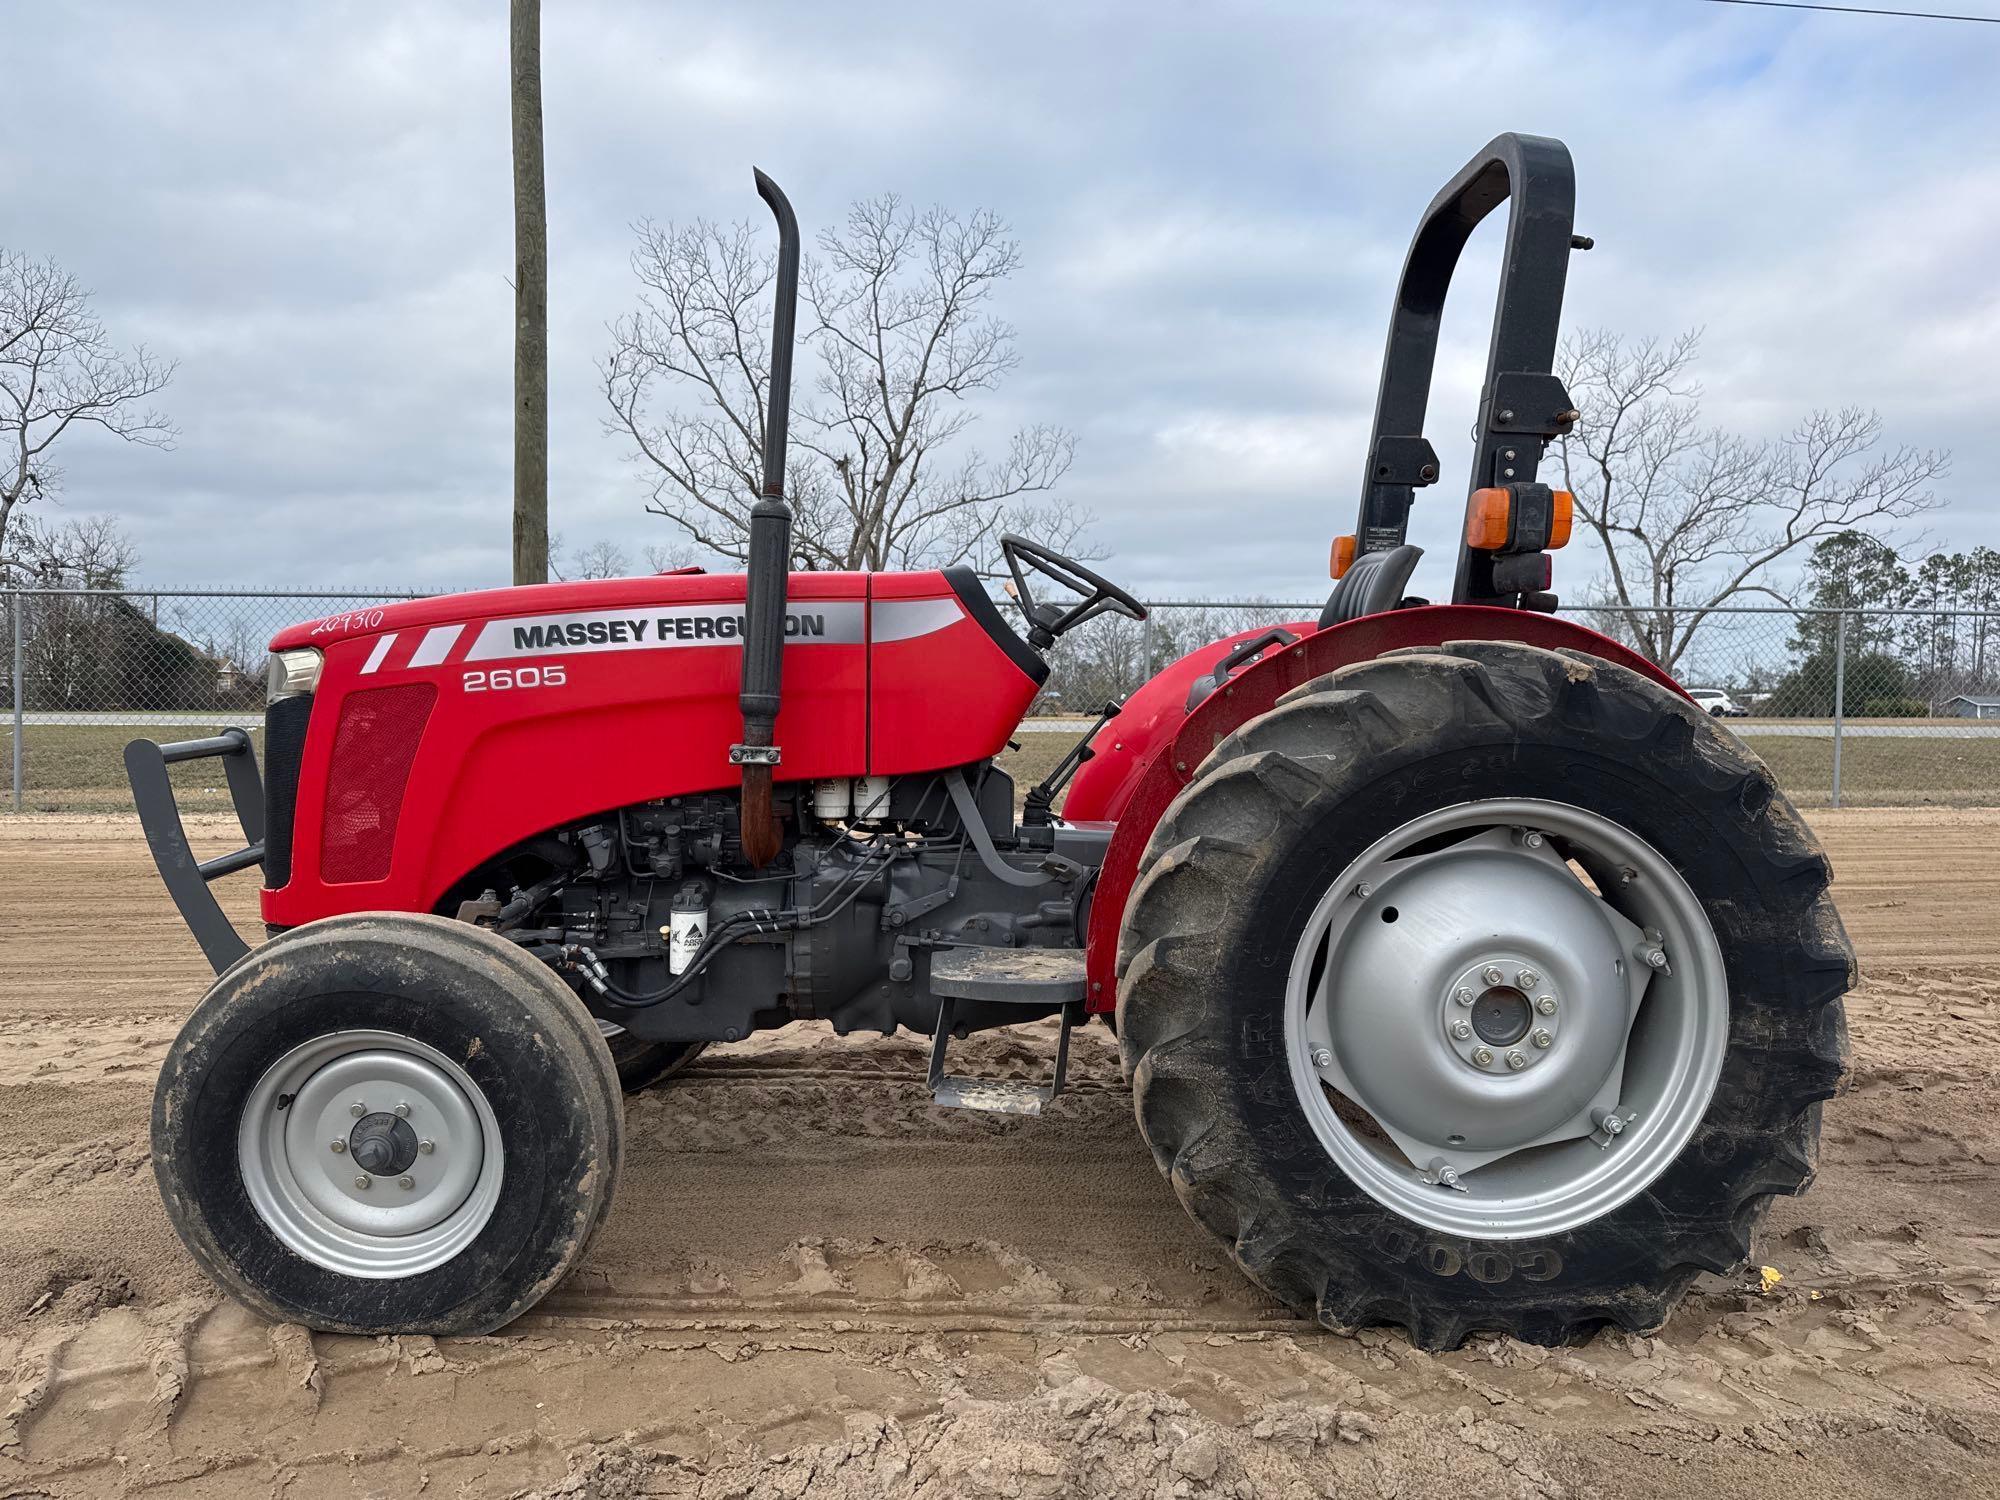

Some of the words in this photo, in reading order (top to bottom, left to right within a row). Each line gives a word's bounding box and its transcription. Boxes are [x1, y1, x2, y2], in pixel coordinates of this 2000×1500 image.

[311, 610, 384, 635] 209310
[513, 619, 649, 650] MASSEY
[657, 614, 825, 641] FERGON
[463, 665, 567, 692] 2605
